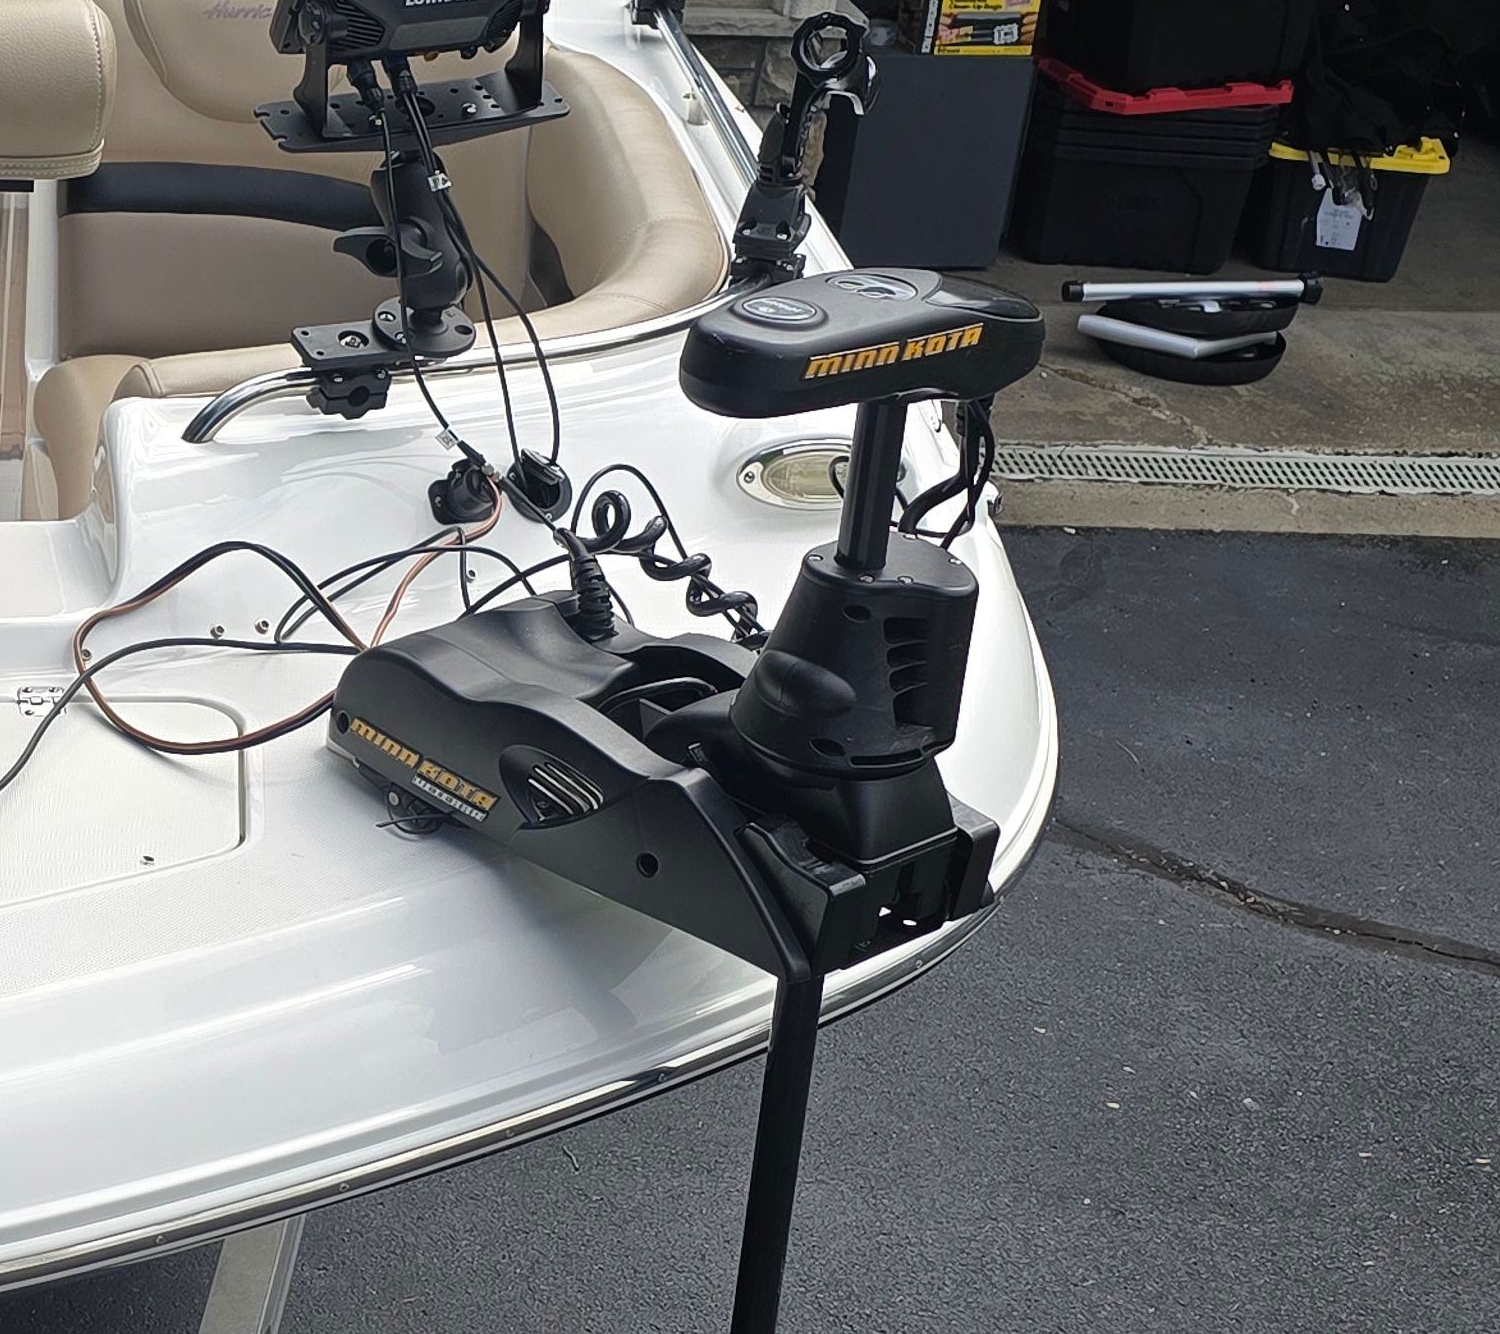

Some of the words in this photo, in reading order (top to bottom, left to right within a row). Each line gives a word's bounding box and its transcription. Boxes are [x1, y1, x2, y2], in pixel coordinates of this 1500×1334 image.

[203, 0, 271, 20] Hurric
[902, 322, 984, 362] KOTA
[417, 759, 497, 810] KOTA
